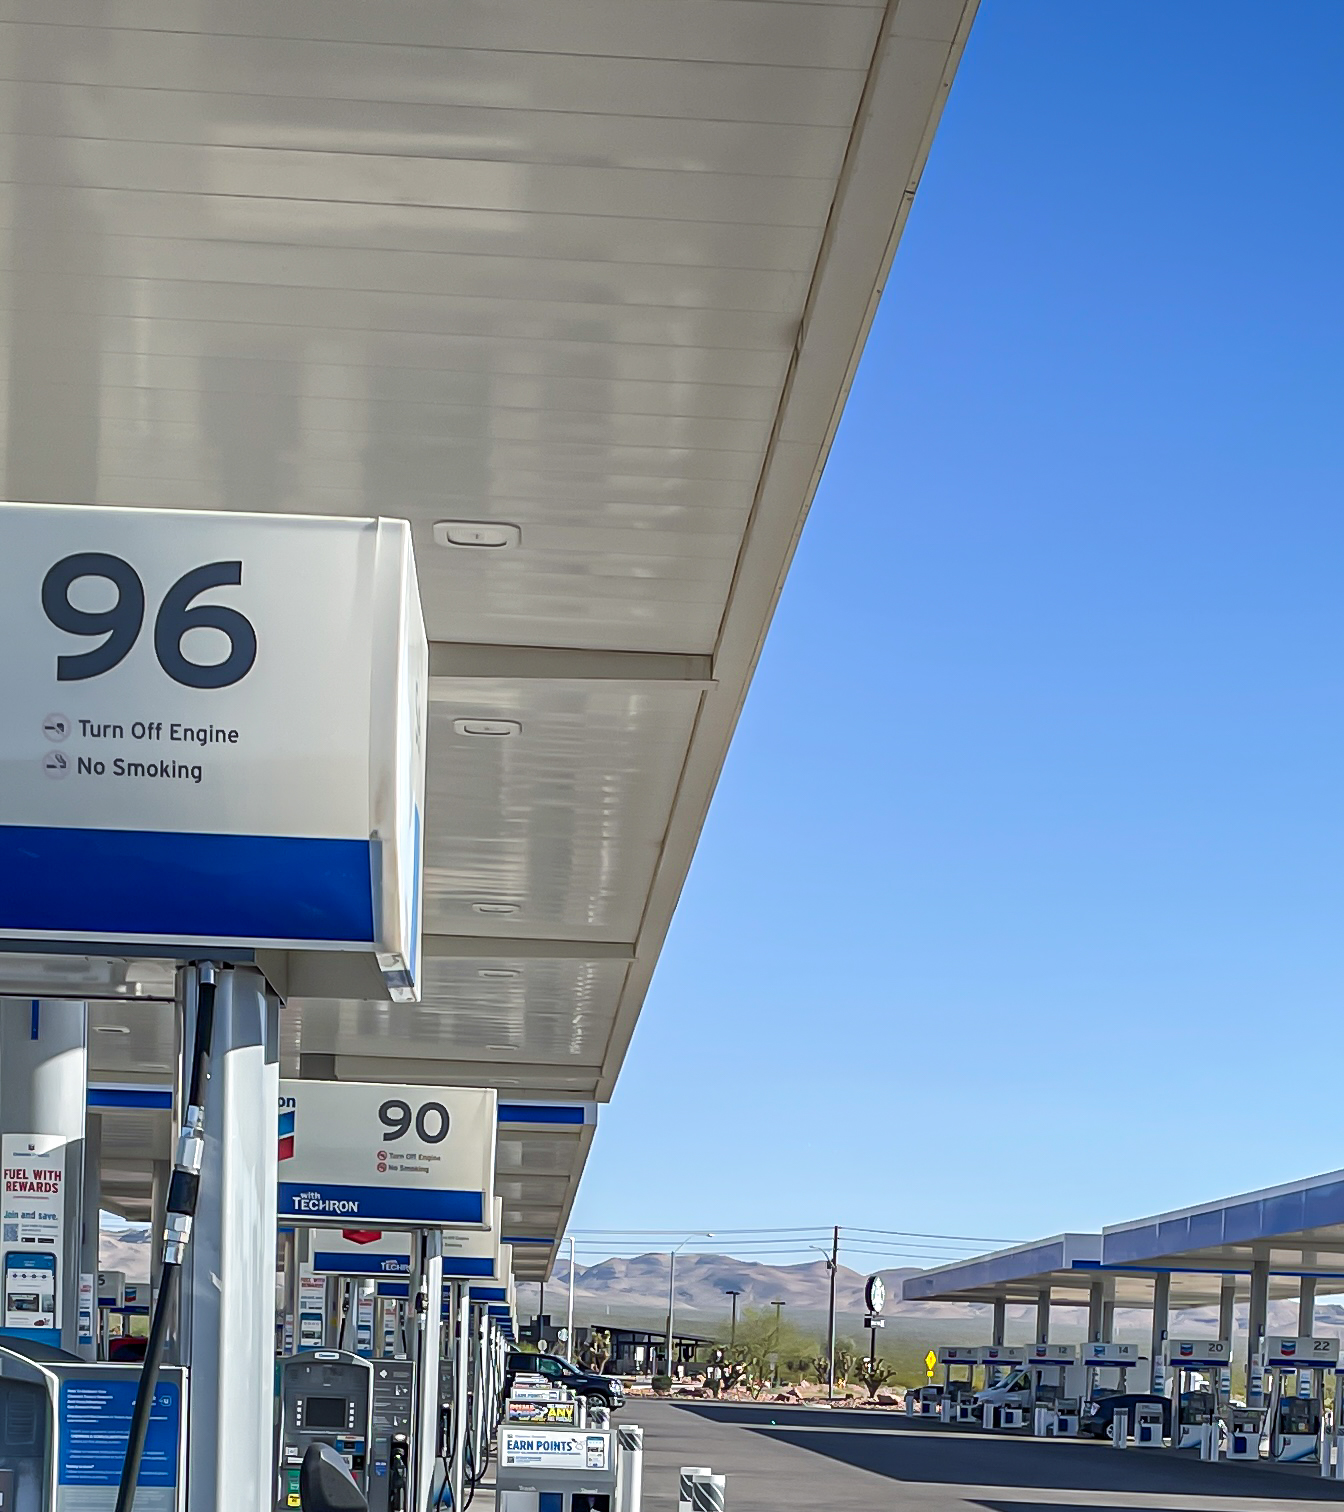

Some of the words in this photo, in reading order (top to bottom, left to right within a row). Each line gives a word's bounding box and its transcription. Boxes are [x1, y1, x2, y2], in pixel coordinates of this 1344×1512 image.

[41, 551, 256, 689] 96
[77, 719, 124, 741] Turn
[131, 719, 162, 742] Off
[169, 721, 240, 747] Engine
[76, 756, 105, 778] No
[111, 757, 203, 784] Smoking
[378, 1099, 450, 1144] 90
[3, 1168, 29, 1180] FUEL
[33, 1169, 62, 1182] WITH
[399, 1164, 430, 1174] Smoking
[5, 1181, 59, 1194] REWARDS
[300, 1191, 321, 1200] with
[292, 1197, 360, 1214] TECHRON
[3, 1209, 19, 1220] Join
[21, 1210, 36, 1219] and
[38, 1211, 59, 1221] save.
[1118, 1346, 1129, 1354] 14
[1208, 1343, 1224, 1352] 20
[1313, 1340, 1330, 1351] 22
[507, 1440, 534, 1451] EARN
[536, 1440, 573, 1452] POINTS
